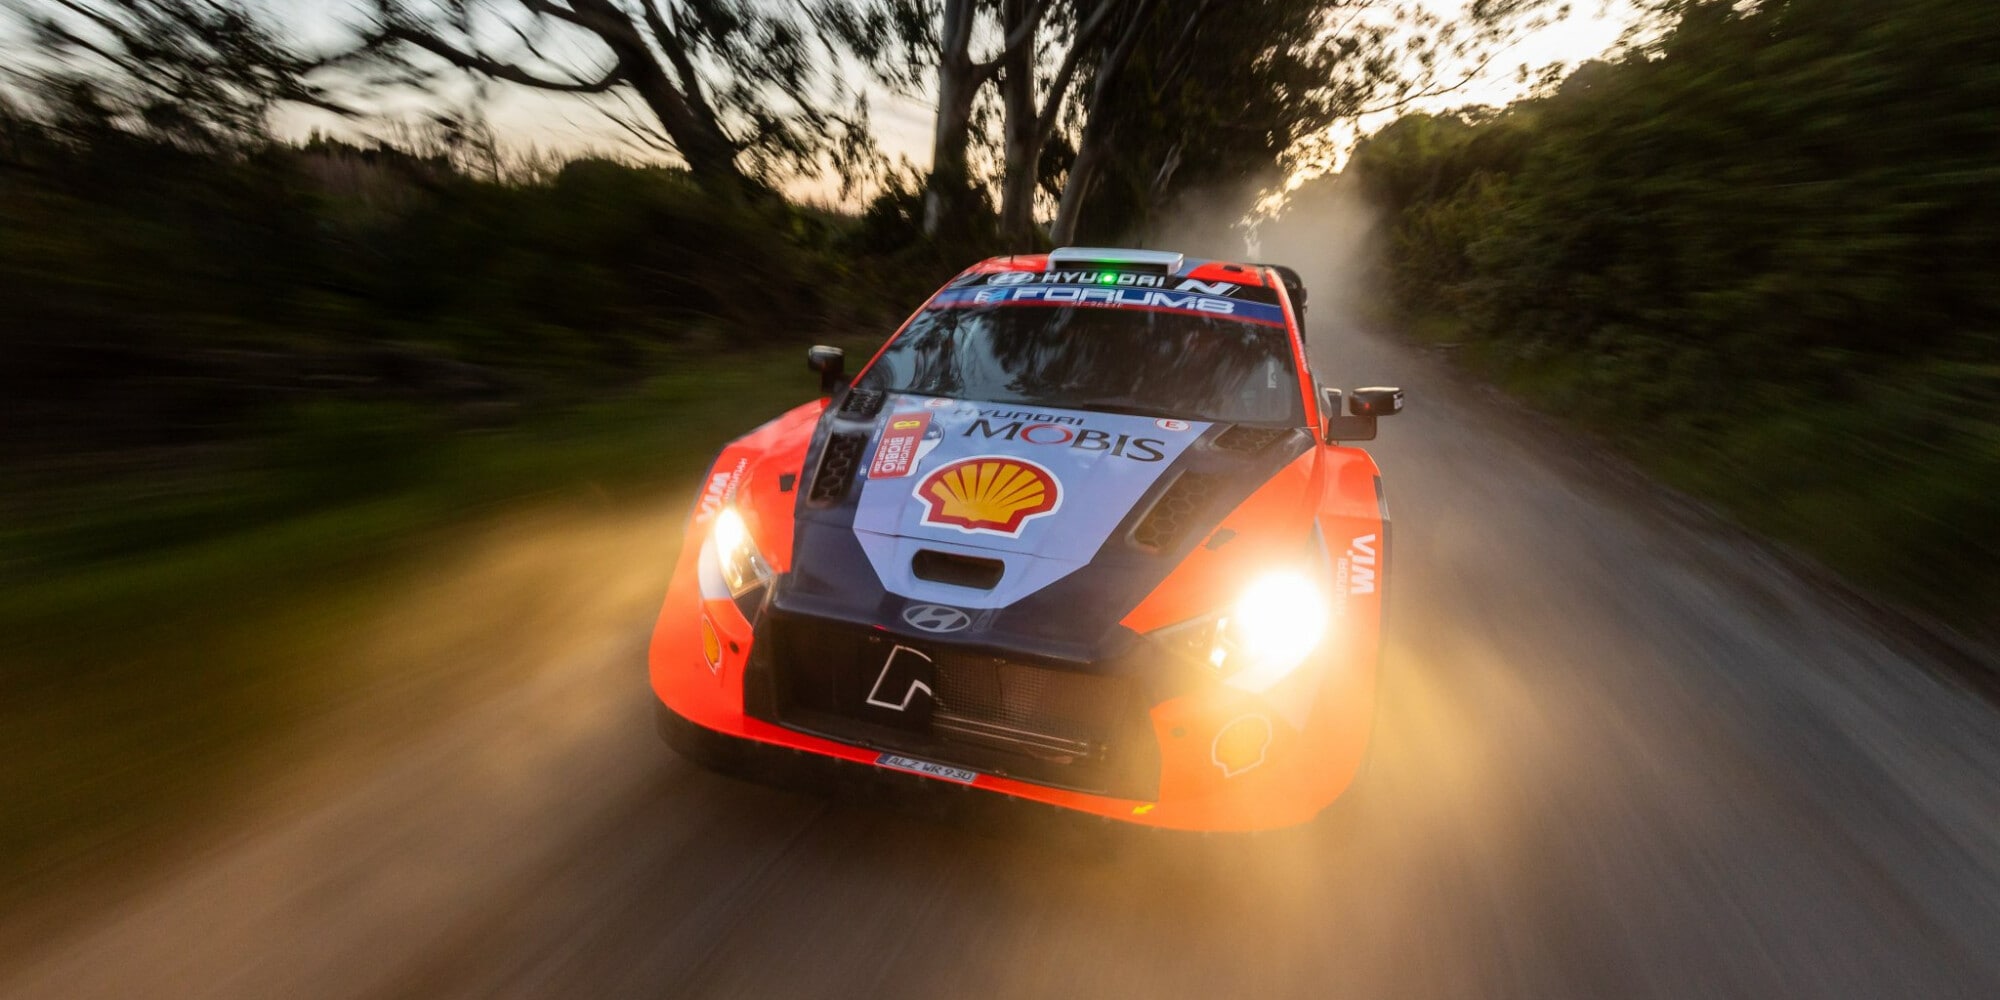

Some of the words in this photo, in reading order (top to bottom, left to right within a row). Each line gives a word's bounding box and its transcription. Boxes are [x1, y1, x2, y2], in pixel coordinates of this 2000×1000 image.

[1012, 286, 1235, 314] FORUM8
[953, 408, 1085, 426] HYUNDAI
[962, 418, 1165, 462] MOBIS
[889, 757, 919, 769] ALZ
[922, 763, 941, 774] WR
